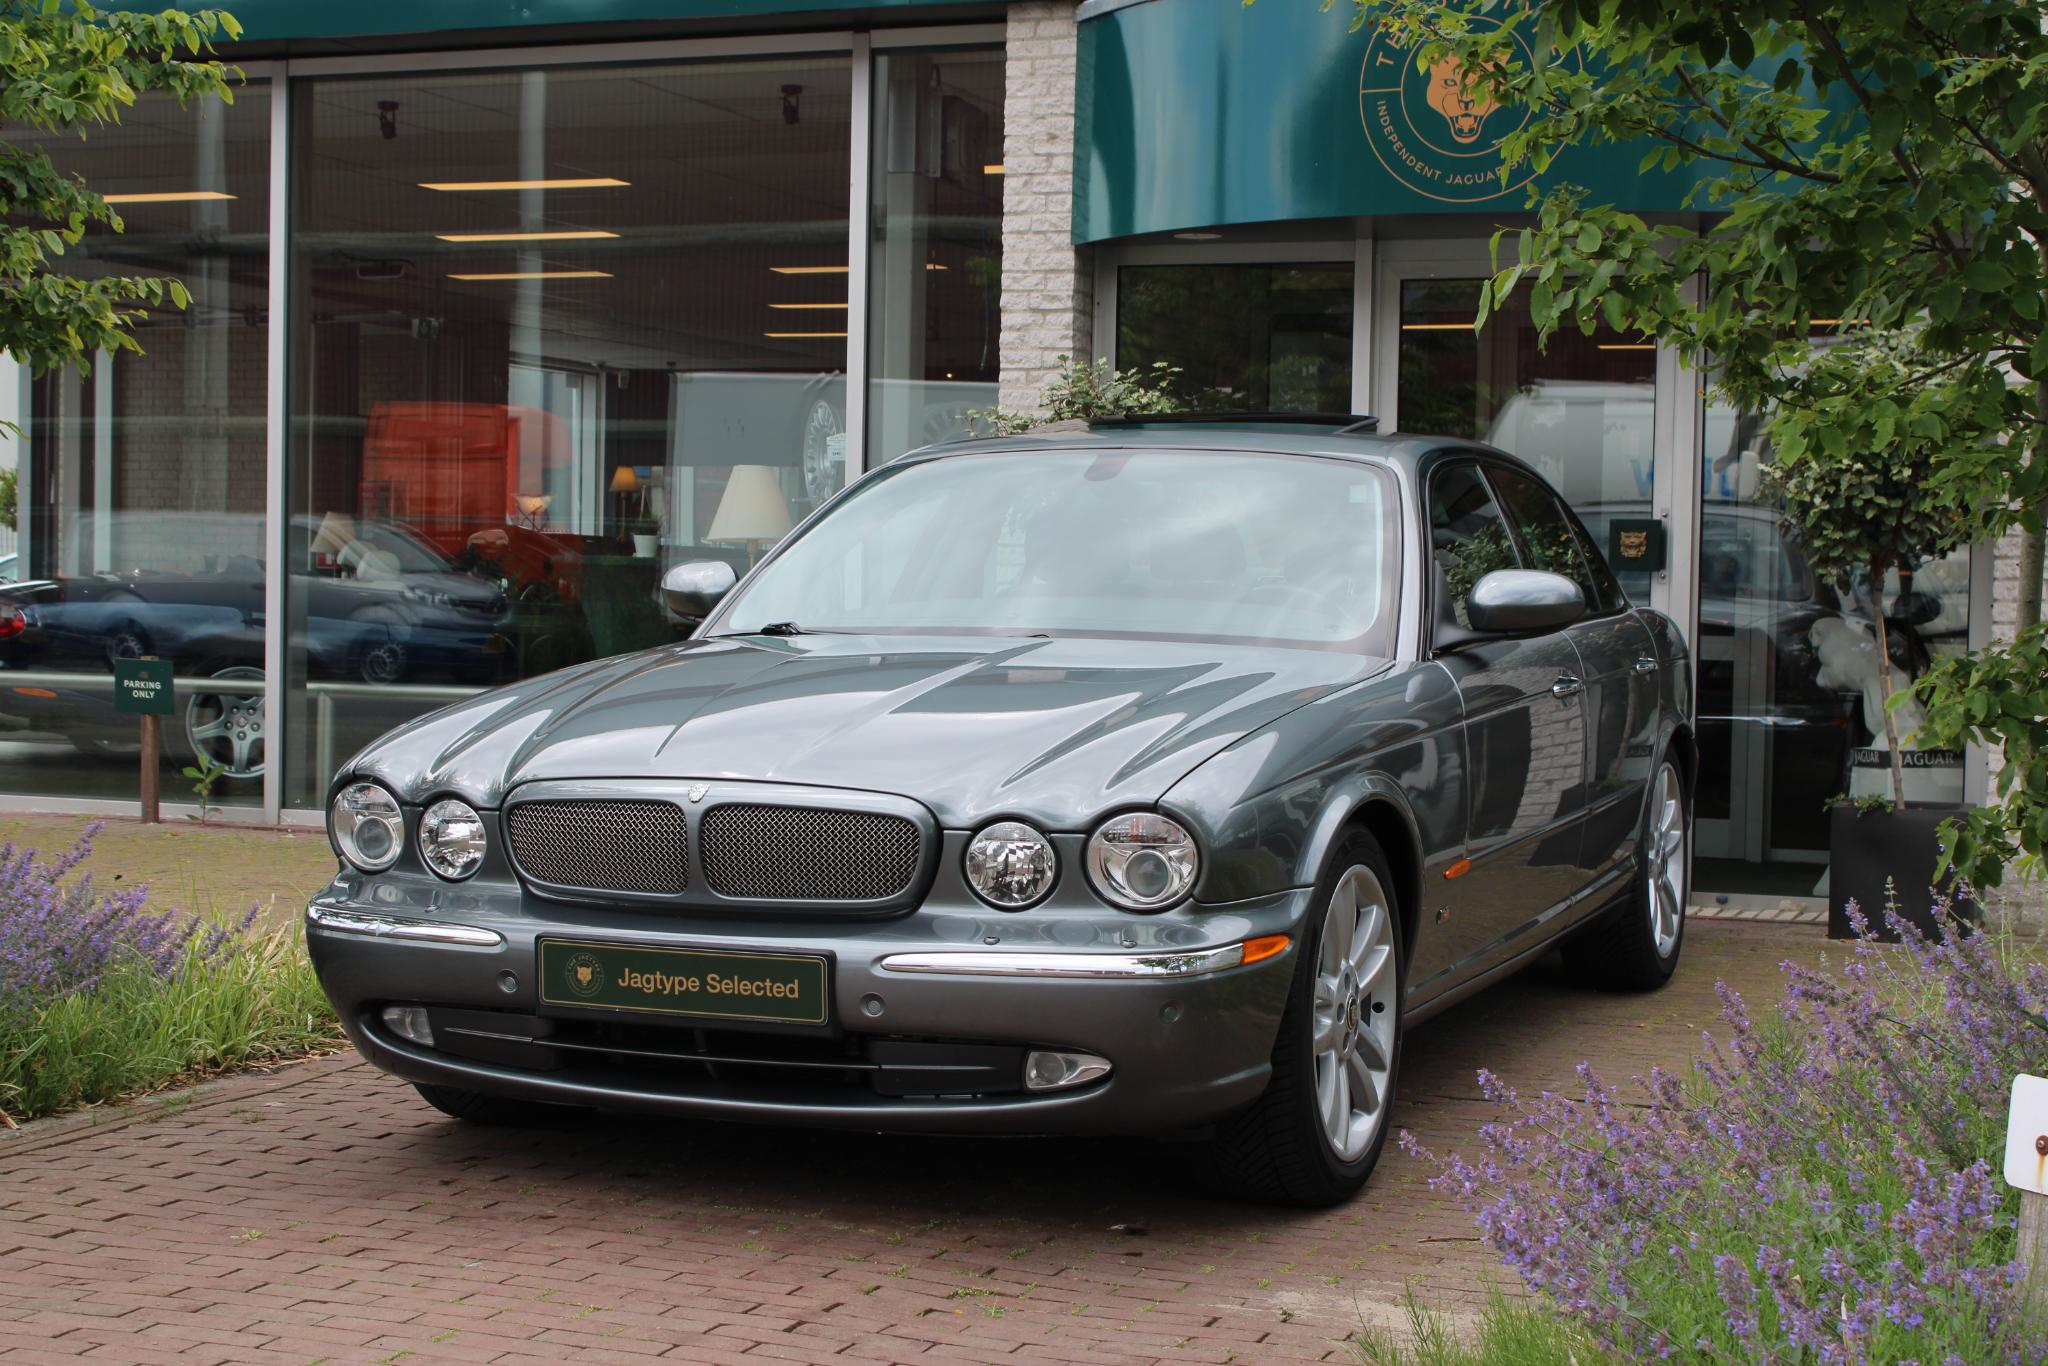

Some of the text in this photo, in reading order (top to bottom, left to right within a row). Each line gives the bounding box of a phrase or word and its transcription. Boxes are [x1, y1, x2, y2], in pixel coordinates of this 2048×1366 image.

[1377, 100, 1442, 181] INDEPENDENT
[123, 680, 161, 690] PARKING
[132, 690, 155, 699] ONLY
[618, 967, 700, 996] Jagtype
[706, 973, 799, 999] Selected
